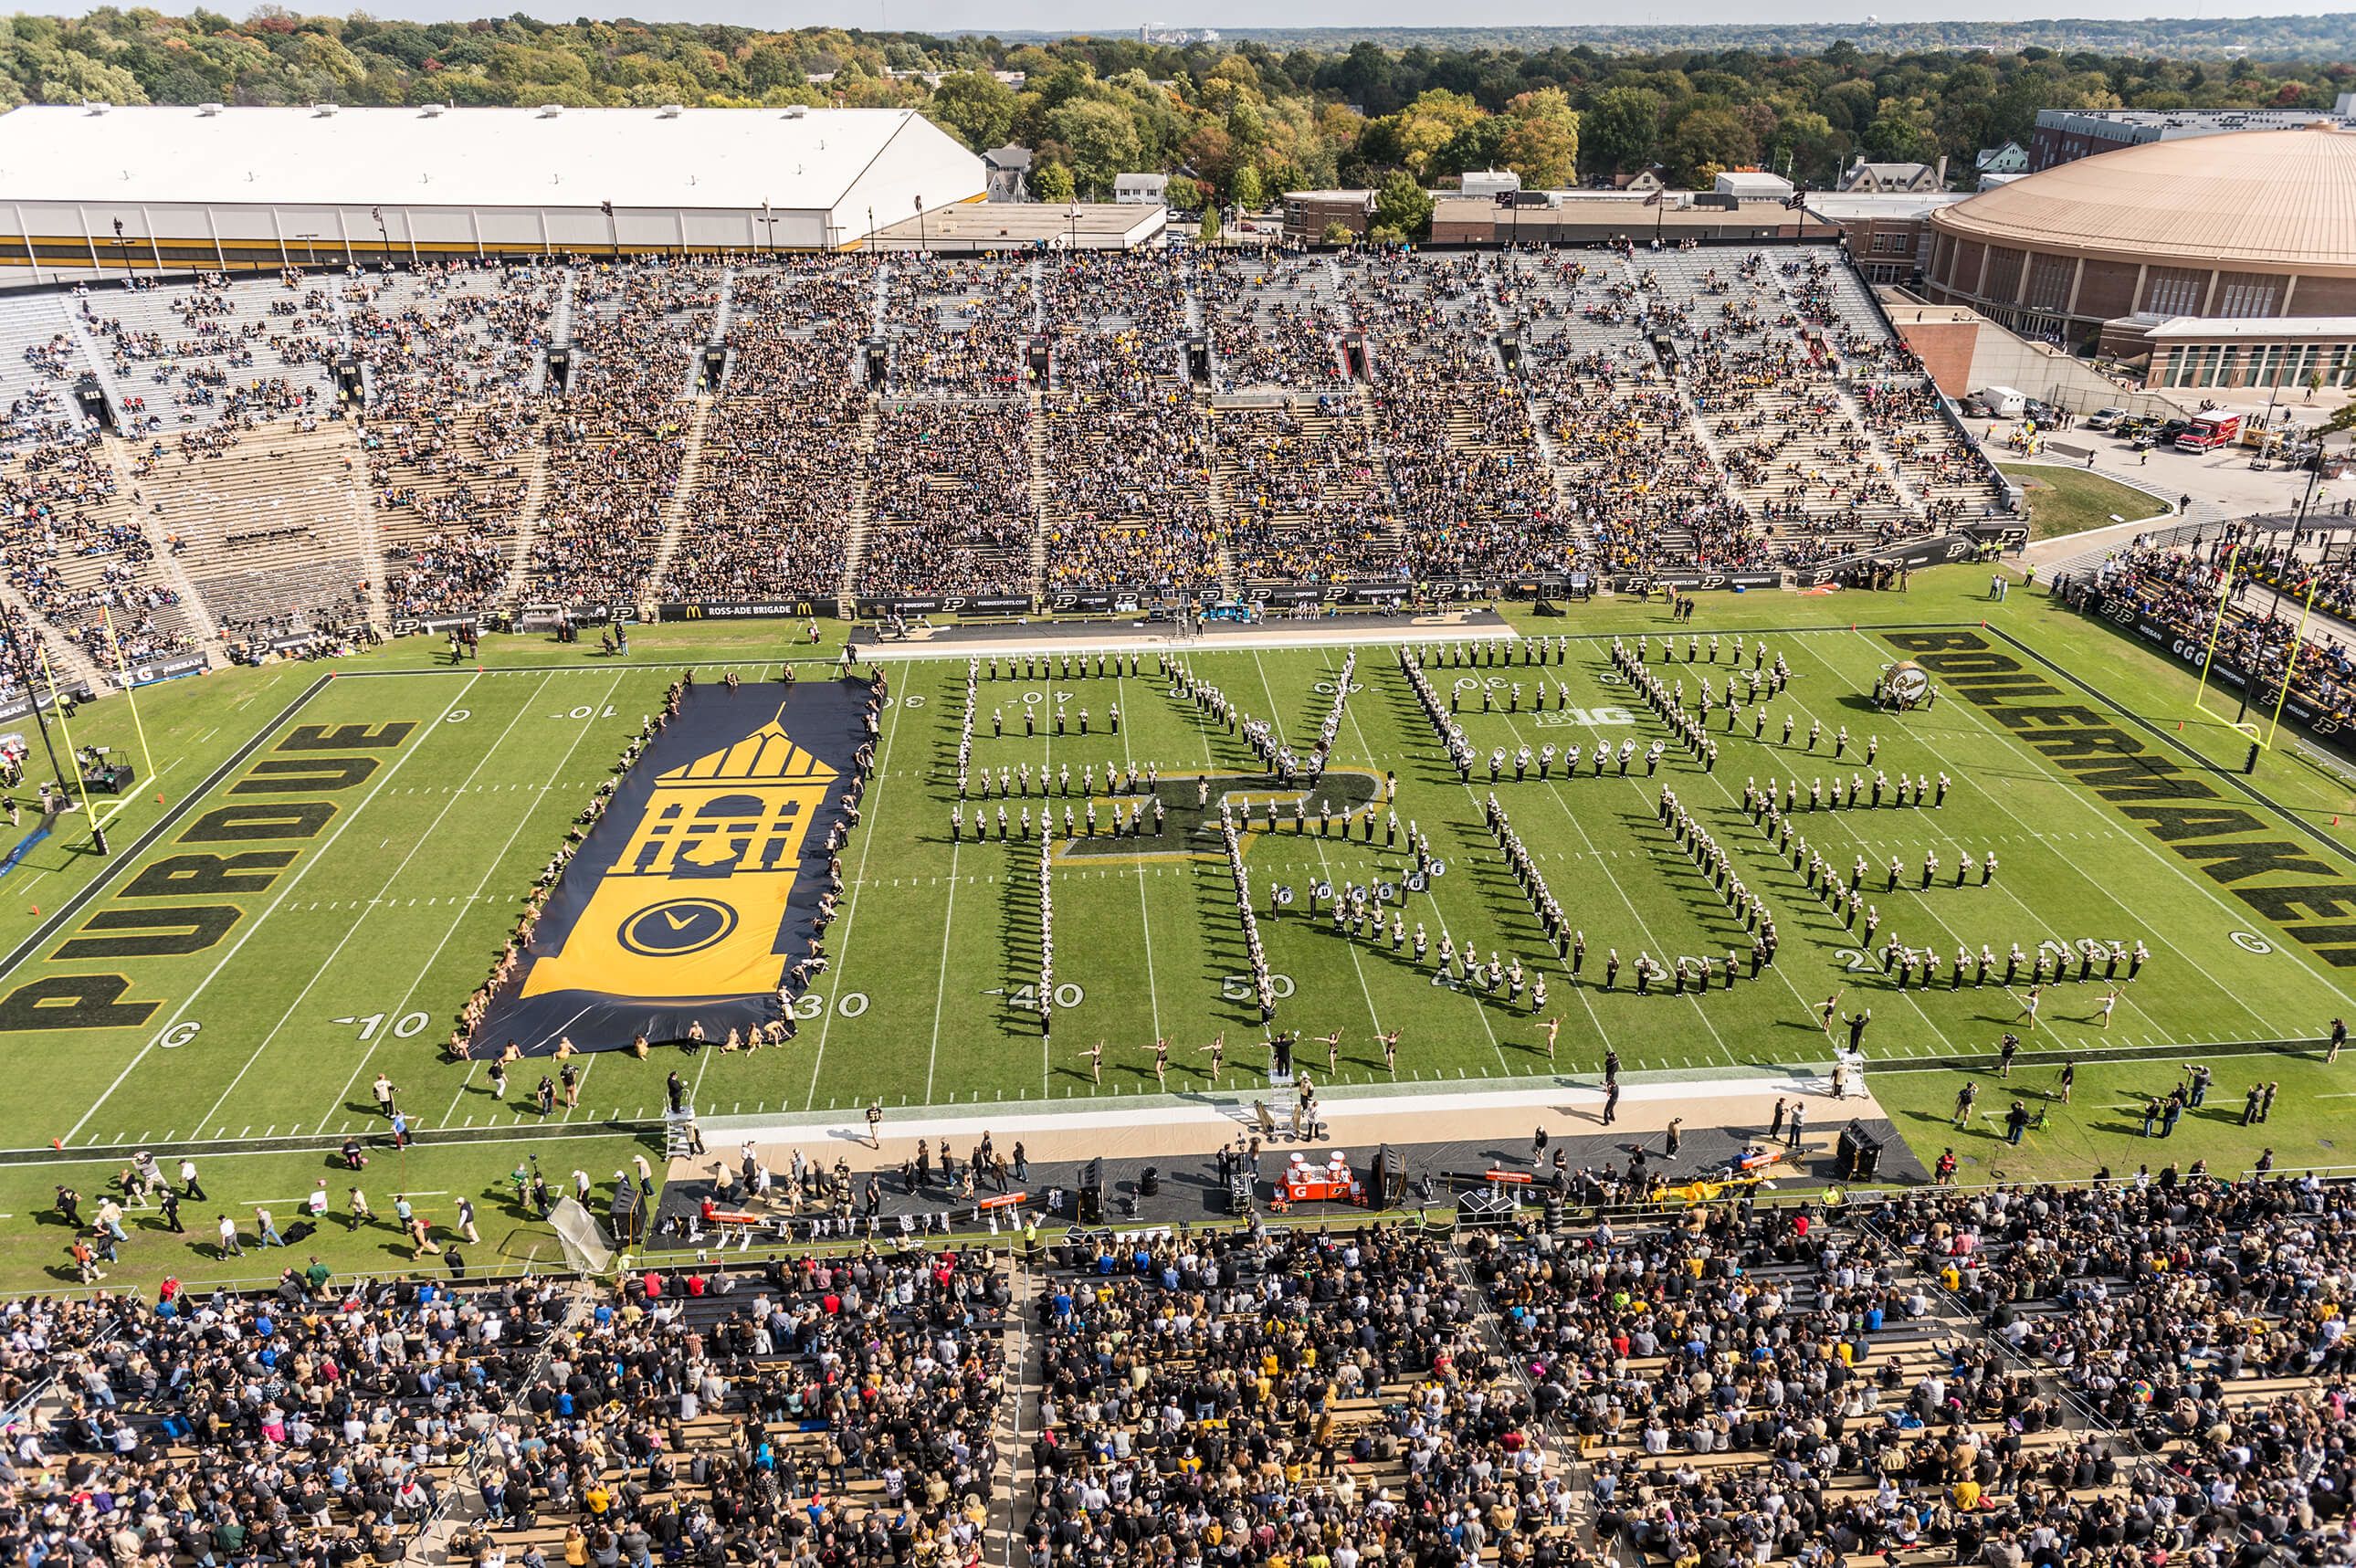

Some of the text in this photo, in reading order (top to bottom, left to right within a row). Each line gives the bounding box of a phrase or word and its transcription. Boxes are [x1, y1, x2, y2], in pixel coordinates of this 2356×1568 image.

[1998, 529, 2027, 546] P
[1946, 542, 1966, 558] P
[1701, 575, 1724, 589] P
[1813, 570, 1833, 584] P
[1248, 589, 1271, 603] P
[1324, 586, 1347, 601] P
[1432, 583, 1456, 597] P
[942, 597, 966, 611] P
[1055, 594, 1078, 609] P
[1117, 593, 1139, 605] P
[709, 605, 791, 616] ROSS-ADE BRIGADE
[2100, 599, 2119, 614] P
[608, 606, 635, 622] P
[2115, 609, 2135, 624] P
[394, 619, 419, 635] P
[2139, 624, 2163, 640] NISSAN
[2172, 639, 2207, 667] G G G
[137, 666, 153, 681] G
[1021, 690, 1076, 704] 40
[567, 704, 619, 720] 10
[2311, 716, 2339, 735] P
[0, 720, 421, 1034] PURDUE
[1435, 866, 1441, 874] E
[1413, 879, 1420, 888] U
[1282, 893, 1289, 901] P
[1383, 888, 1390, 897] D
[2228, 931, 2274, 954] G
[1220, 973, 1297, 1001] 50
[1007, 982, 1086, 1009] 40
[793, 992, 870, 1020] 30
[353, 1010, 431, 1042] 10
[159, 1020, 203, 1049] G
[1294, 1186, 1307, 1197] G
[1318, 1237, 1329, 1246] 70
[42, 1314, 53, 1326] 12
[1146, 1406, 1158, 1417] 15
[1287, 1400, 1297, 1414] 15
[803, 1467, 812, 1475] 21
[1818, 1468, 1831, 1481] 21
[1117, 1480, 1127, 1491] 15
[1146, 1489, 1160, 1500] 40
[2154, 1528, 2168, 1543] 53
[1562, 1544, 1569, 1556] 5
